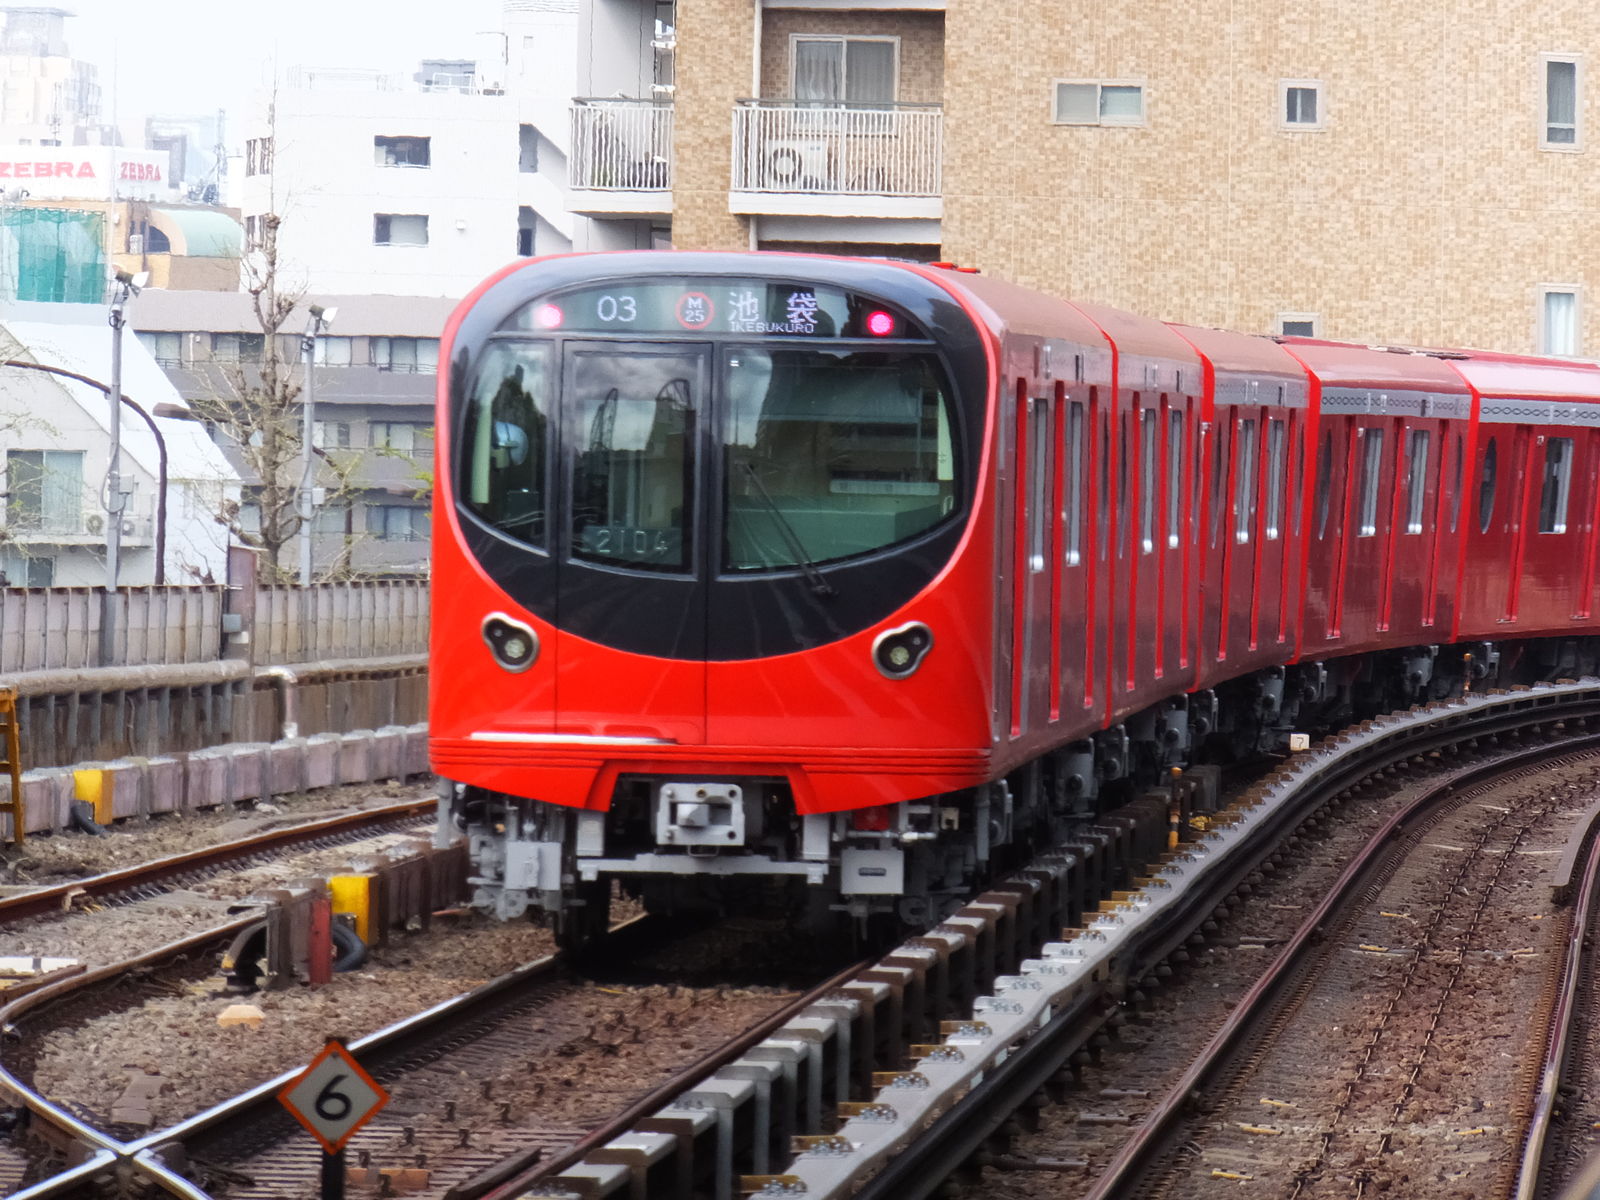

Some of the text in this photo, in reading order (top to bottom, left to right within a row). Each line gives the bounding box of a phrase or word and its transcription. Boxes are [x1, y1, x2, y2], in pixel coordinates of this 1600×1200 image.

[0, 162, 96, 178] ZEBRA
[120, 162, 161, 181] ZEBRA
[597, 295, 637, 322] 03
[687, 297, 702, 309] M
[728, 291, 818, 324] 池袋
[685, 309, 705, 322] 25
[730, 321, 814, 334] IKEBUKURO
[597, 529, 669, 554] 2104
[315, 1074, 352, 1121] 6
